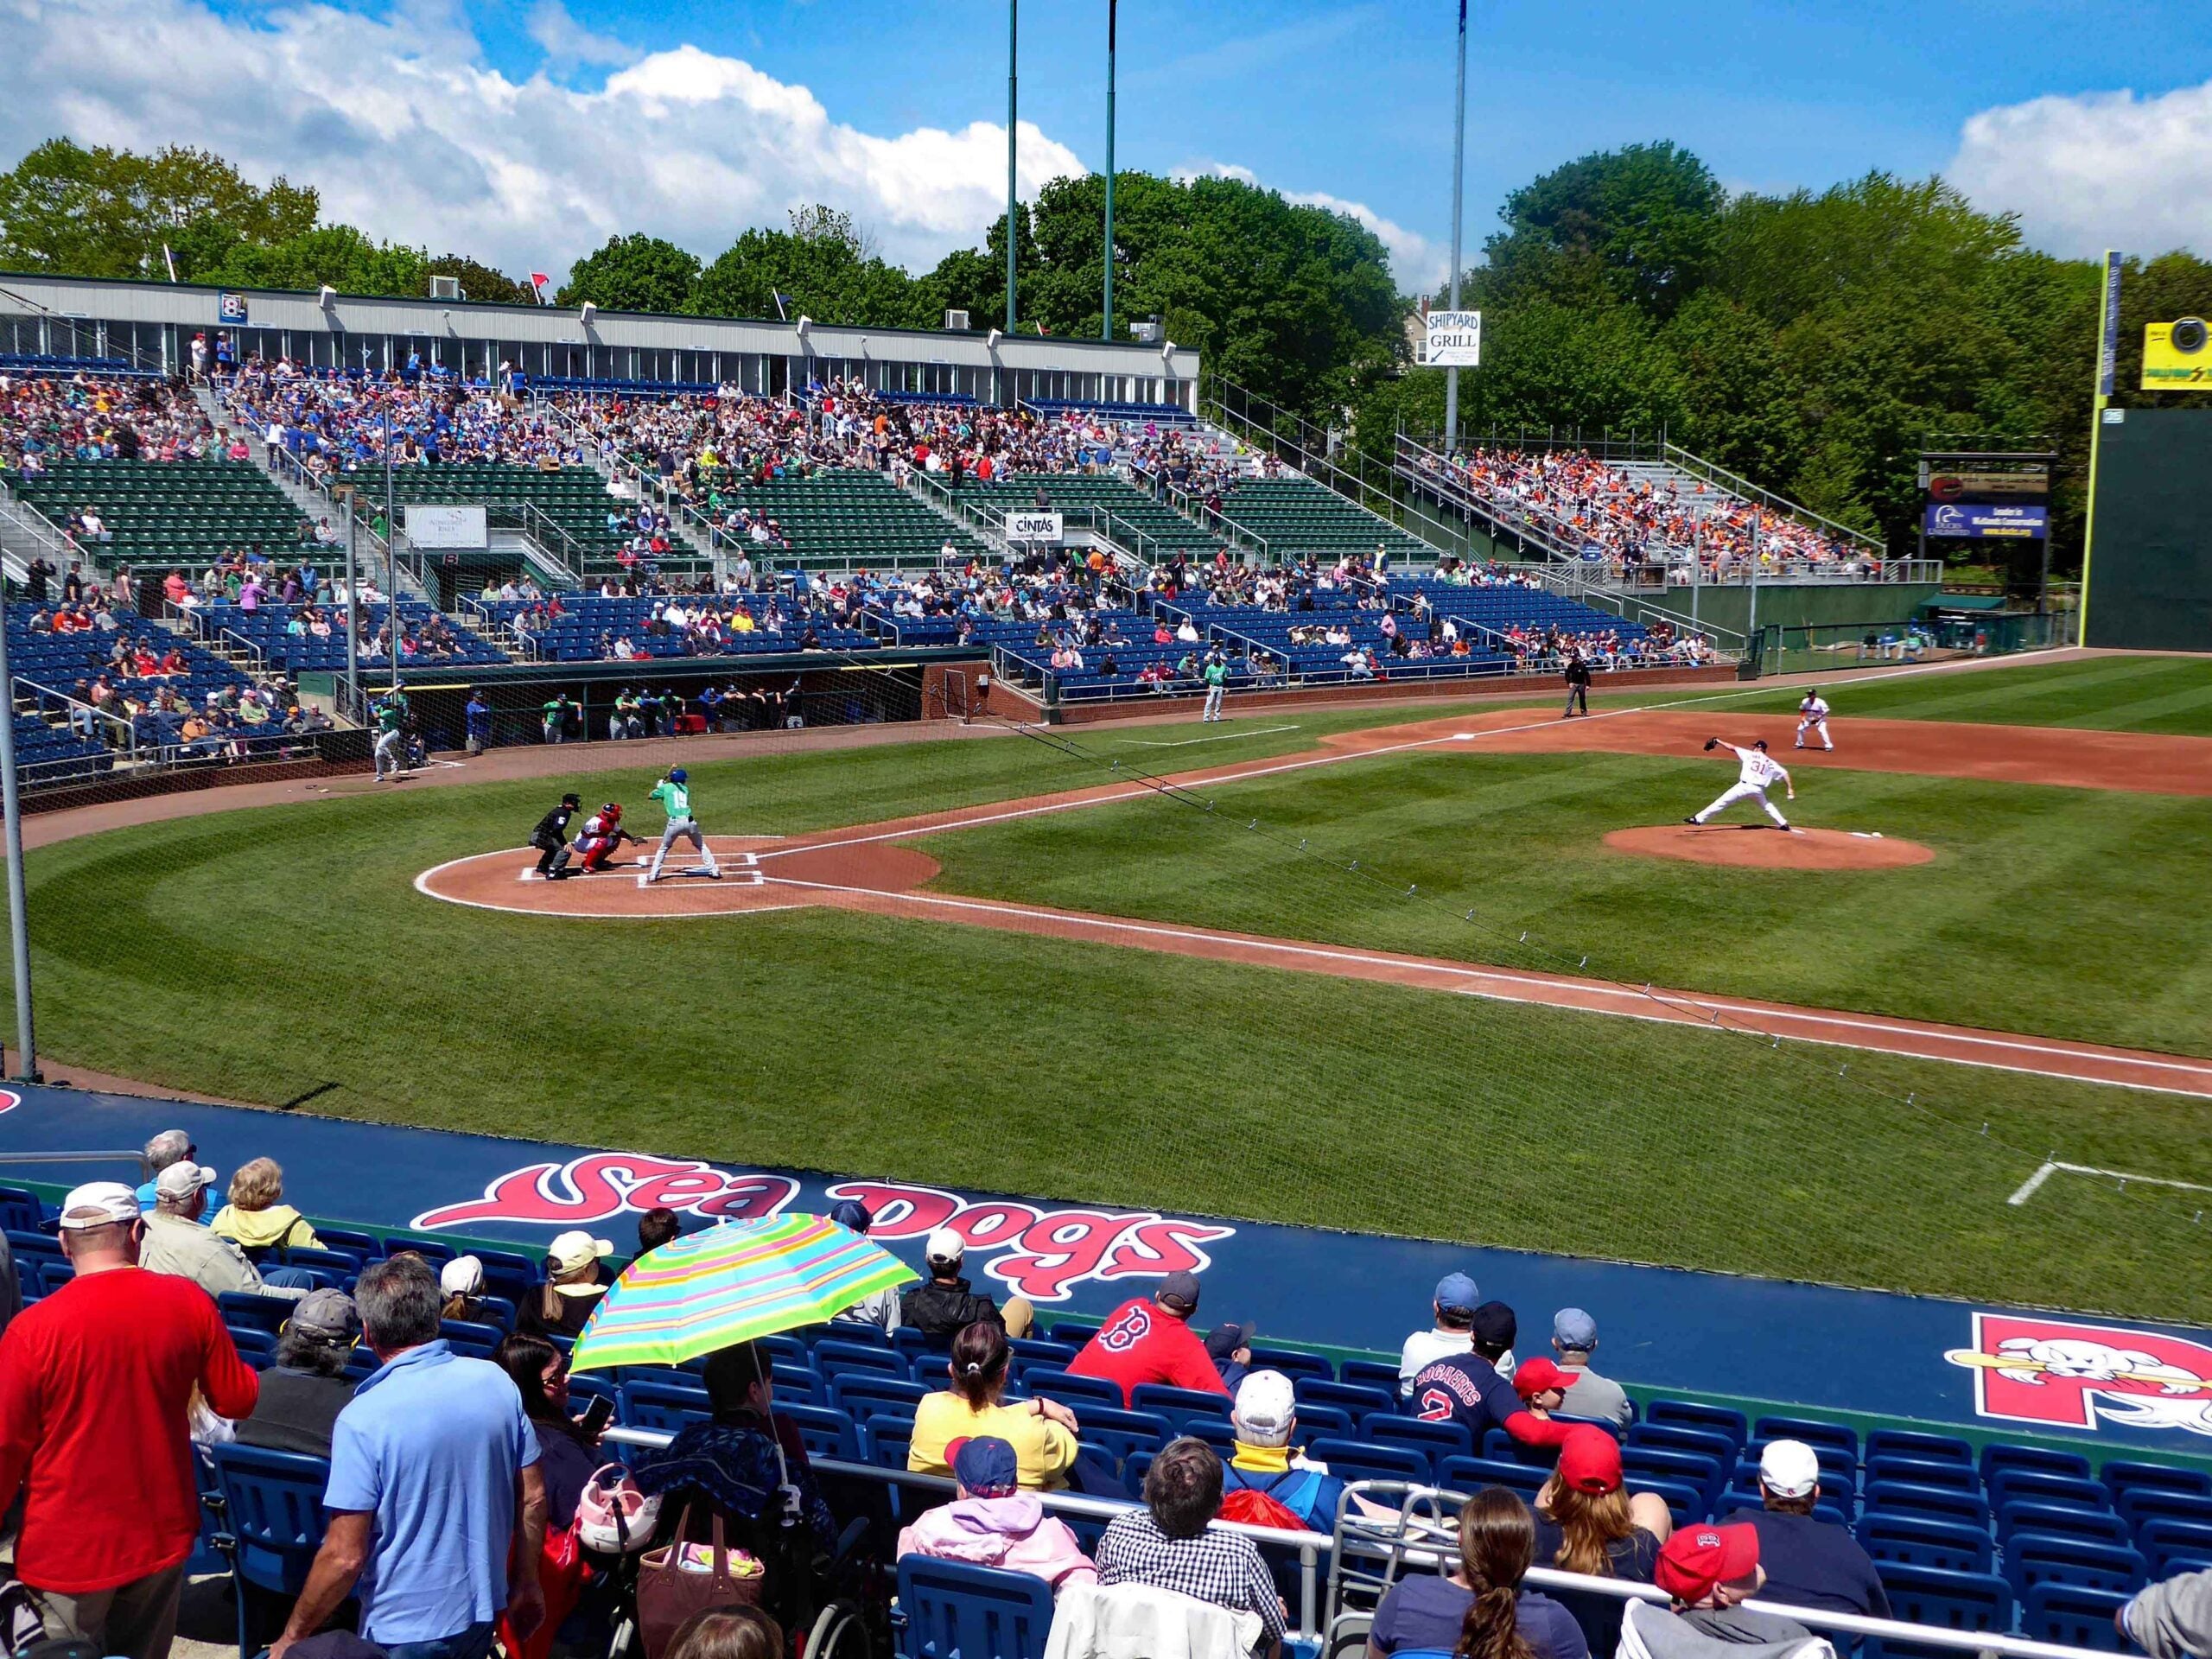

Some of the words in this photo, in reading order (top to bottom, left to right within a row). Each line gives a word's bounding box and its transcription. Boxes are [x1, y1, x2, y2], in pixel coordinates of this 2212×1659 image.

[1429, 313, 1478, 330] SHIPYARD
[1430, 334, 1477, 347] GRILL
[1751, 760, 1765, 775] 31
[673, 790, 688, 809] 19
[410, 1152, 800, 1230] Sea
[825, 1181, 1236, 1301] Dogs
[1098, 1306, 1151, 1352] B
[1417, 1388, 1454, 1421] 2
